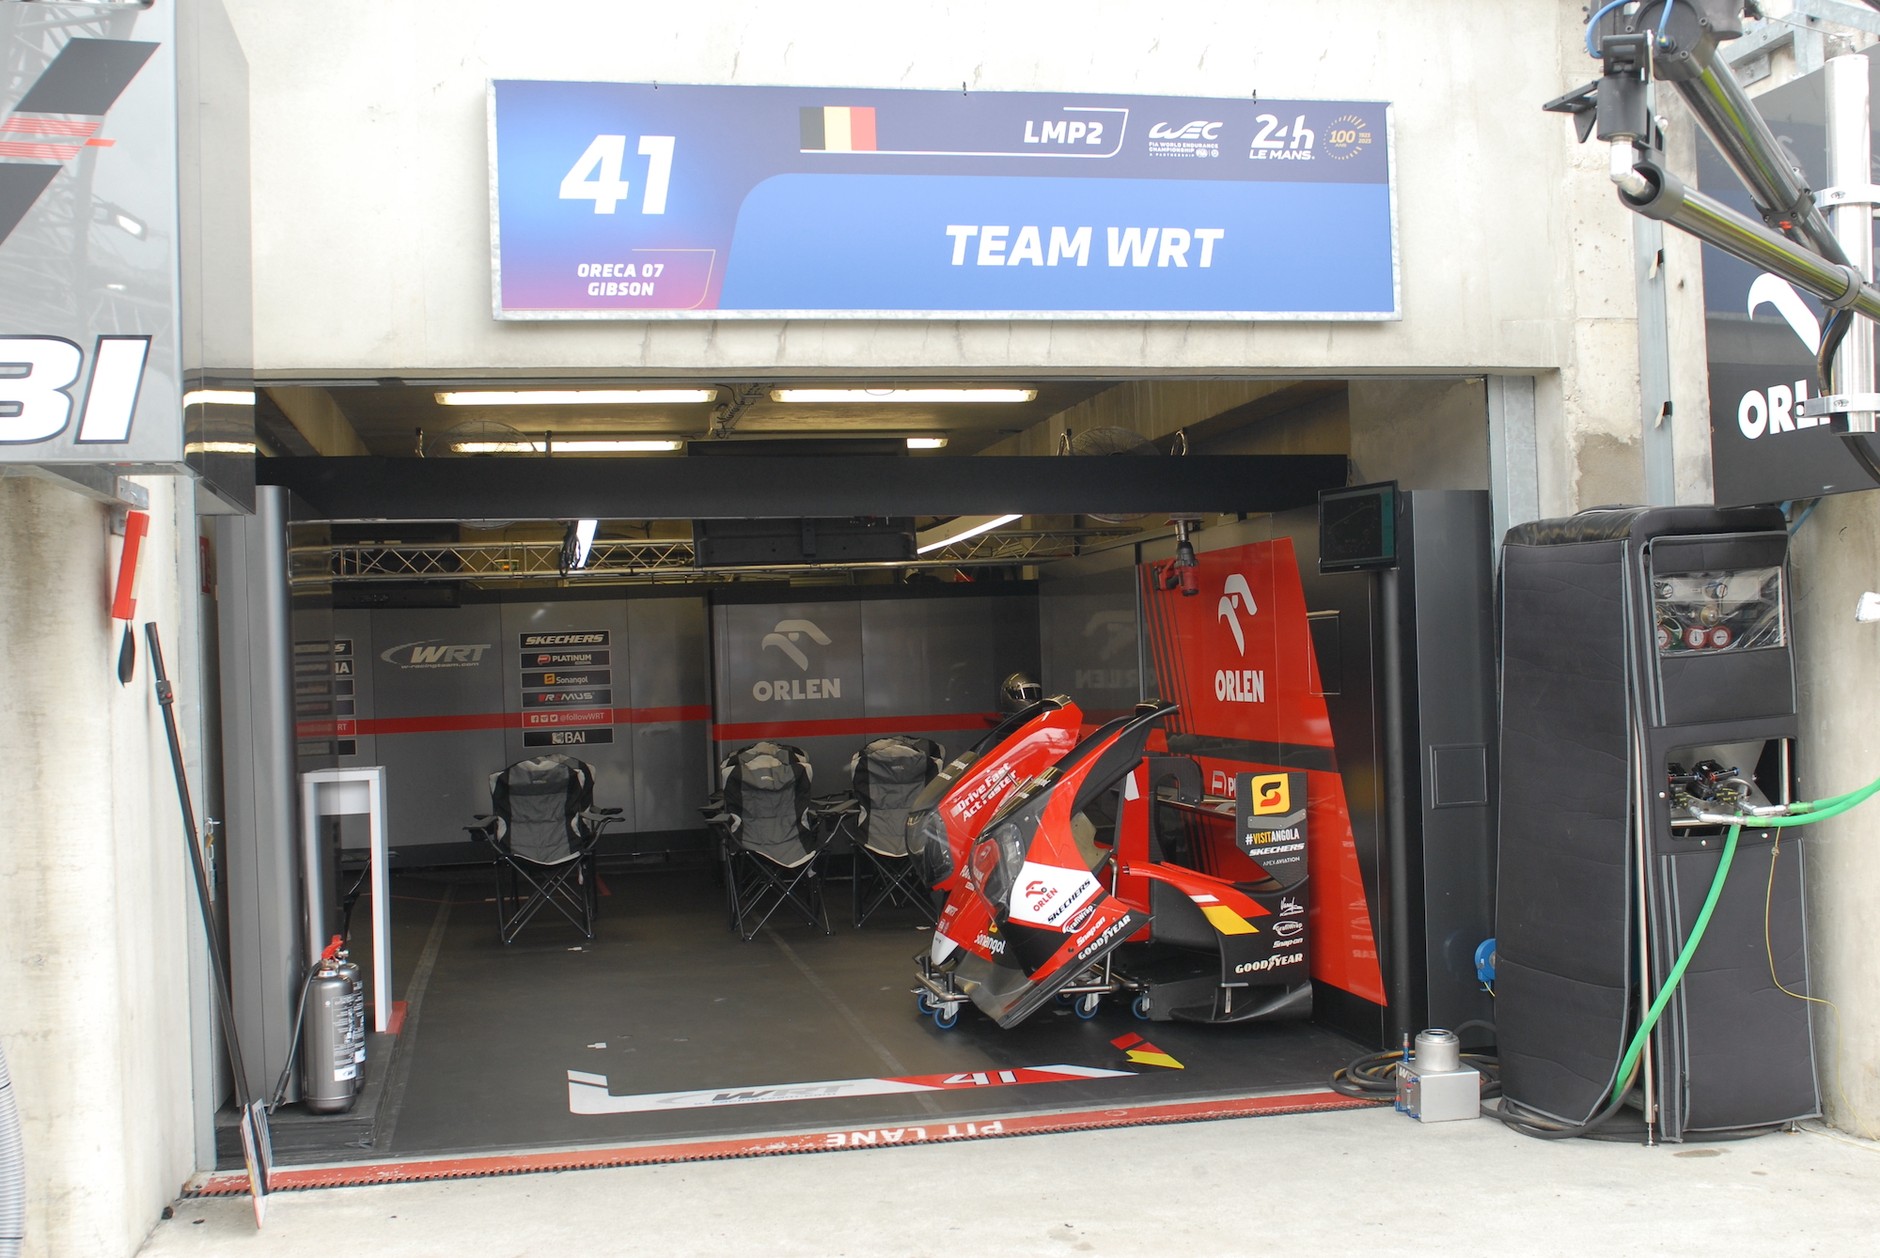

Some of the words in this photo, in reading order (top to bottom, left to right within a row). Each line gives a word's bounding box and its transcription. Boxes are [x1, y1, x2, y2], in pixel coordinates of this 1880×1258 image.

[1023, 120, 1104, 144] LMP2
[1251, 113, 1315, 150] 24h
[1329, 129, 1356, 143] 100
[1249, 150, 1269, 160] LE
[559, 134, 676, 215] 41
[945, 225, 1093, 267] TEAM
[1106, 227, 1225, 269] WRT
[577, 263, 636, 278] ORECA
[641, 263, 665, 278] 07
[587, 281, 655, 297] GIBSON
[1738, 379, 1831, 440] ORL
[525, 634, 605, 645] SKECHERS
[410, 644, 491, 664] WRT
[552, 654, 592, 662] PLATINUM
[556, 675, 589, 685] Sonangol
[1214, 669, 1265, 703] ORLEN
[752, 678, 841, 702] ORLEN
[559, 712, 605, 722] @followWRT
[564, 731, 586, 744] BAI
[983, 762, 1012, 788] Fast
[1245, 828, 1301, 846] #VISITANGOLA
[1248, 842, 1306, 857] SKECHERS
[1033, 887, 1058, 912] ORLEN
[1047, 878, 1091, 924] SKECHERS
[1077, 914, 1132, 961] GOODYEAR
[1234, 952, 1304, 974] GOODYEAR
[942, 1070, 1018, 1086] 41
[712, 1084, 855, 1101] WRT
[826, 1126, 928, 1147] LANE
[940, 1120, 1003, 1138] PIT
